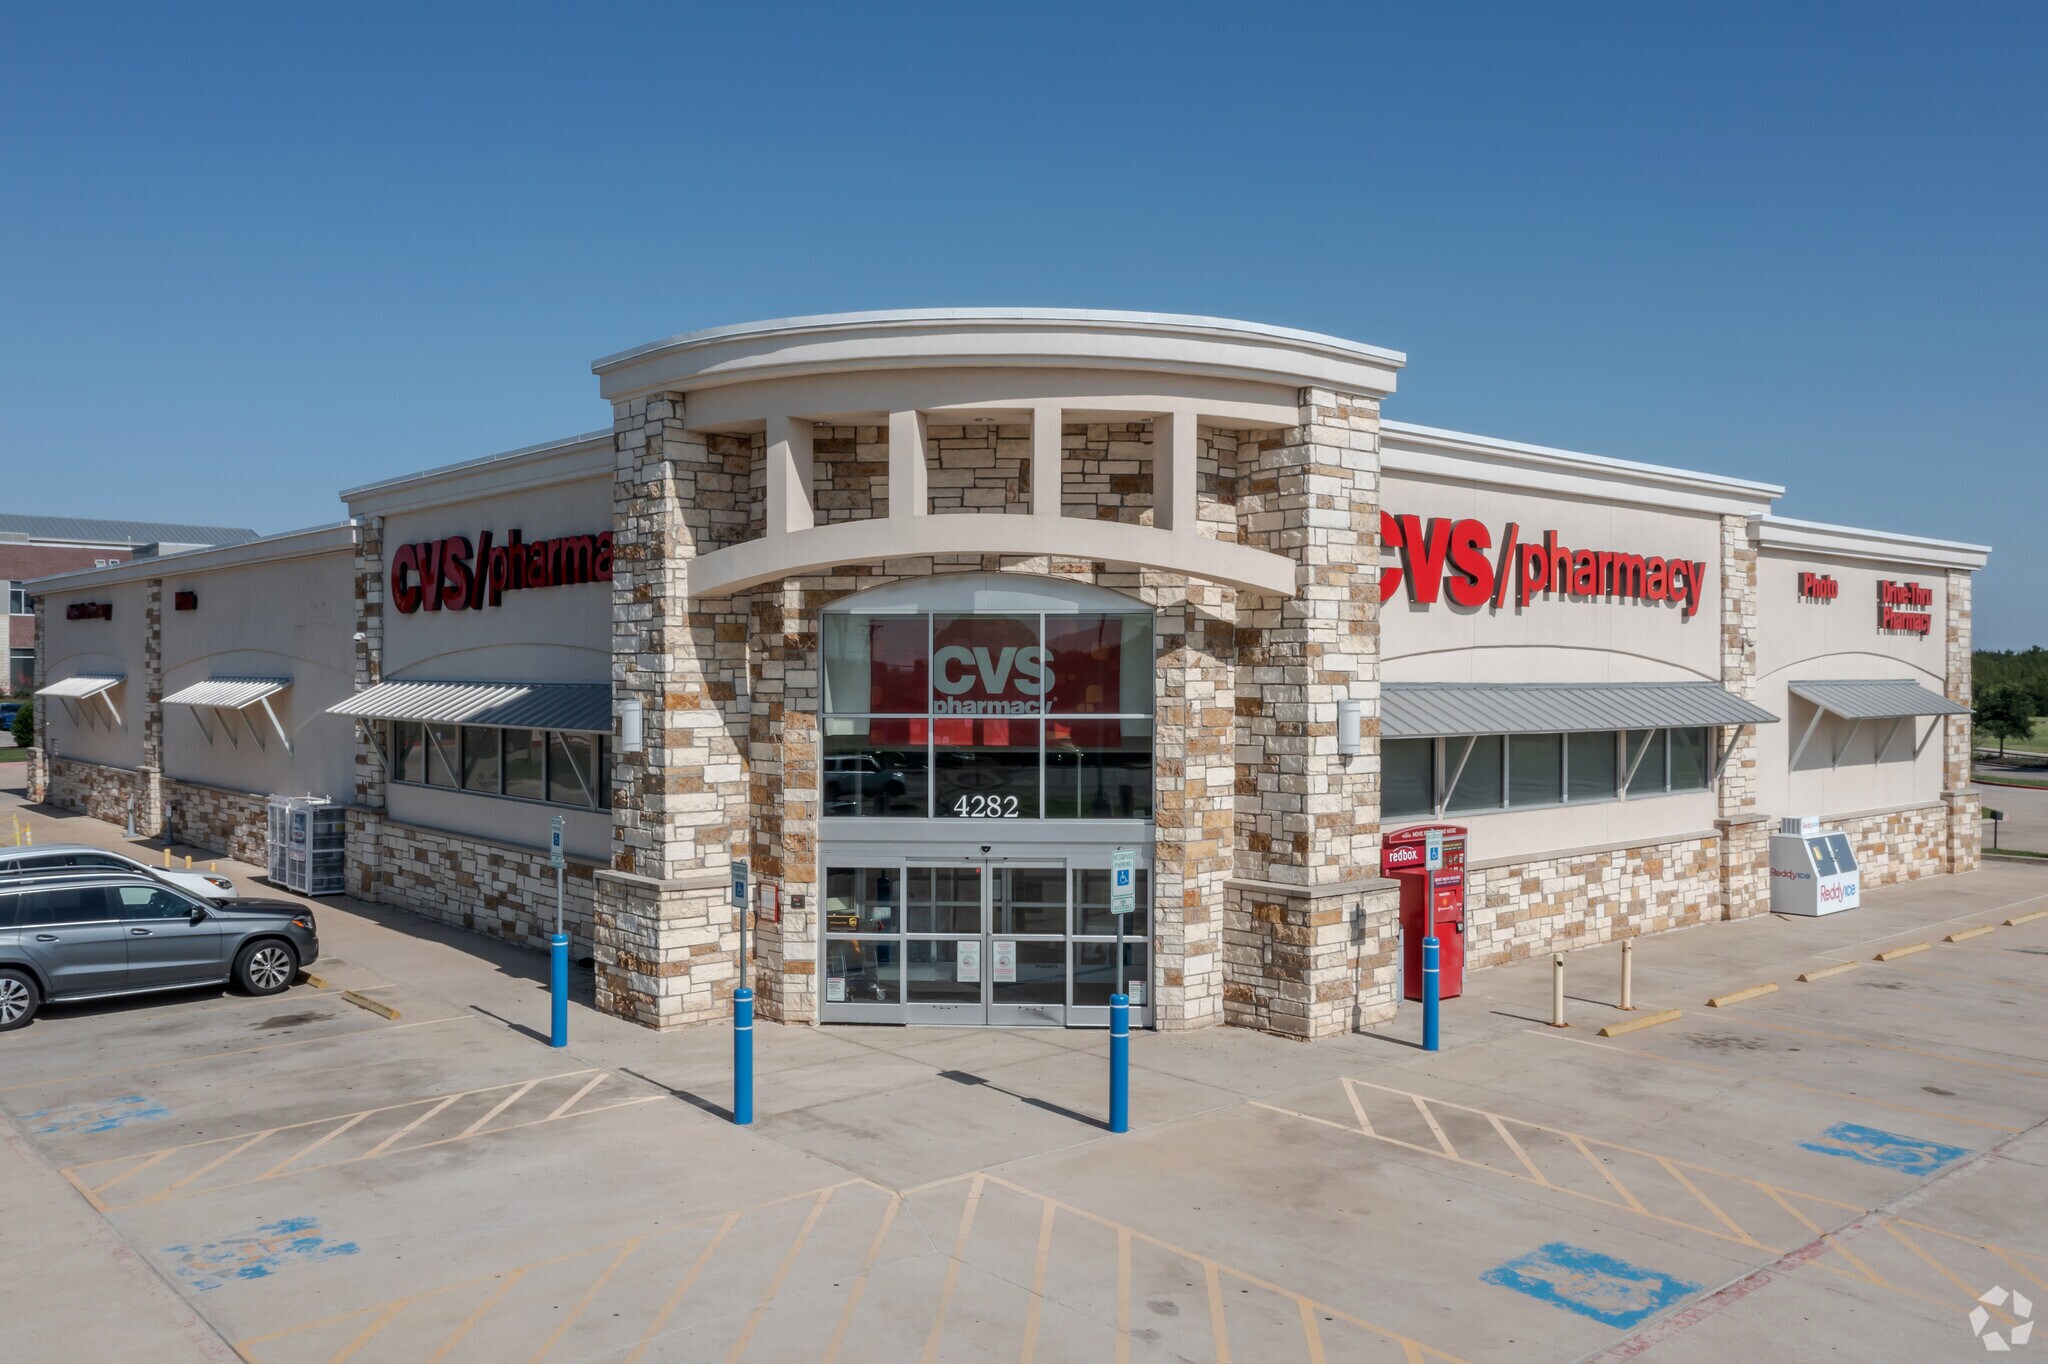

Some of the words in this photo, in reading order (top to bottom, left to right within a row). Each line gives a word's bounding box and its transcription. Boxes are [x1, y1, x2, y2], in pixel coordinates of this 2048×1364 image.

[1799, 572, 1838, 598] Photo
[1878, 580, 1932, 605] Drive-Thru
[1879, 606, 1931, 635] Pharmacy
[933, 646, 1055, 695] CVS
[954, 795, 1019, 818] 4282
[1389, 849, 1417, 862] redbox
